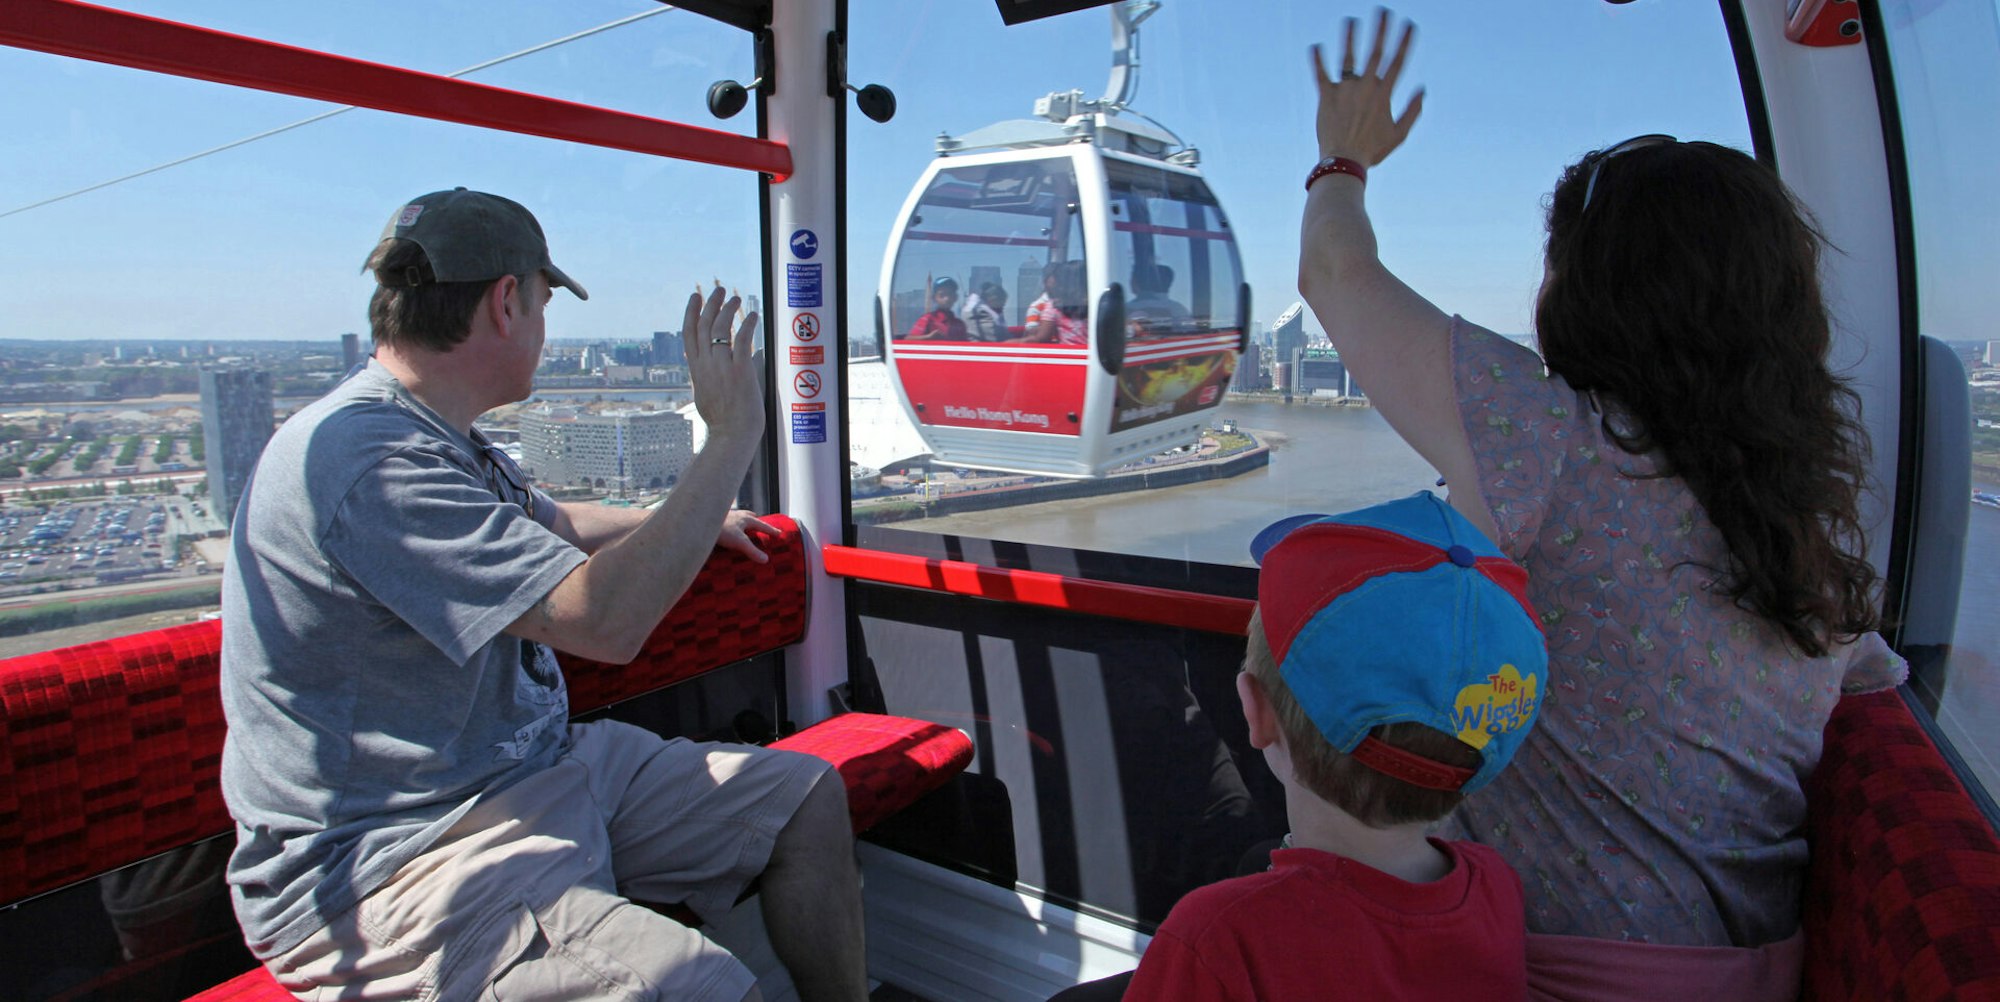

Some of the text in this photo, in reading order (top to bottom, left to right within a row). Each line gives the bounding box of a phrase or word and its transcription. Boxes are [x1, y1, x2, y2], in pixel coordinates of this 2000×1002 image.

[943, 405, 1049, 428] Hello Hong Kong
[1488, 674, 1517, 695] The
